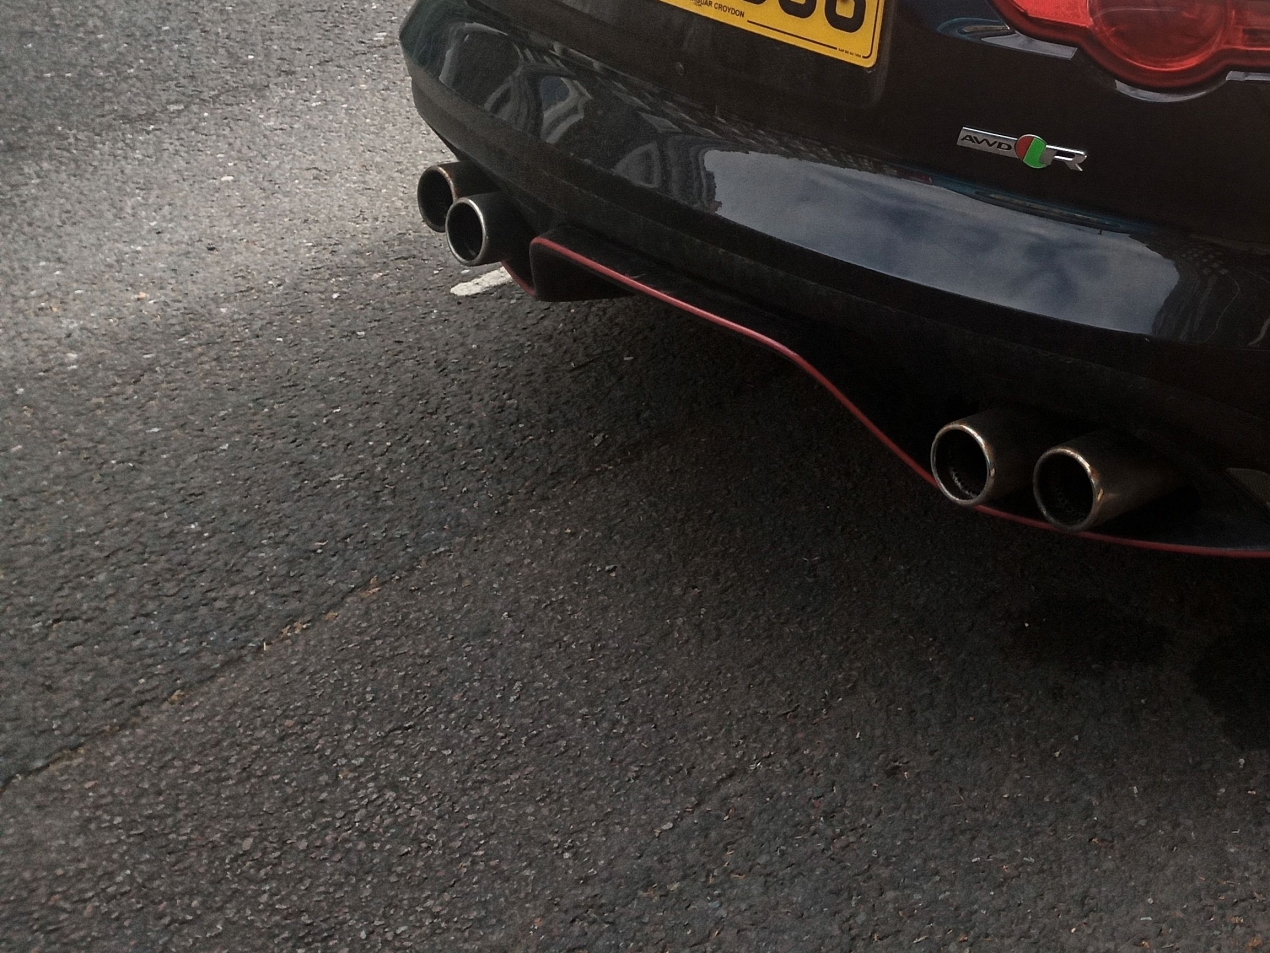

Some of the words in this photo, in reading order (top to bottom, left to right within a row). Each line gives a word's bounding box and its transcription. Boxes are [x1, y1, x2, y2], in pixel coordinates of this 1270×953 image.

[714, 2, 745, 18] CROYDON
[960, 134, 1013, 151] AWD
[1044, 144, 1088, 172] R
